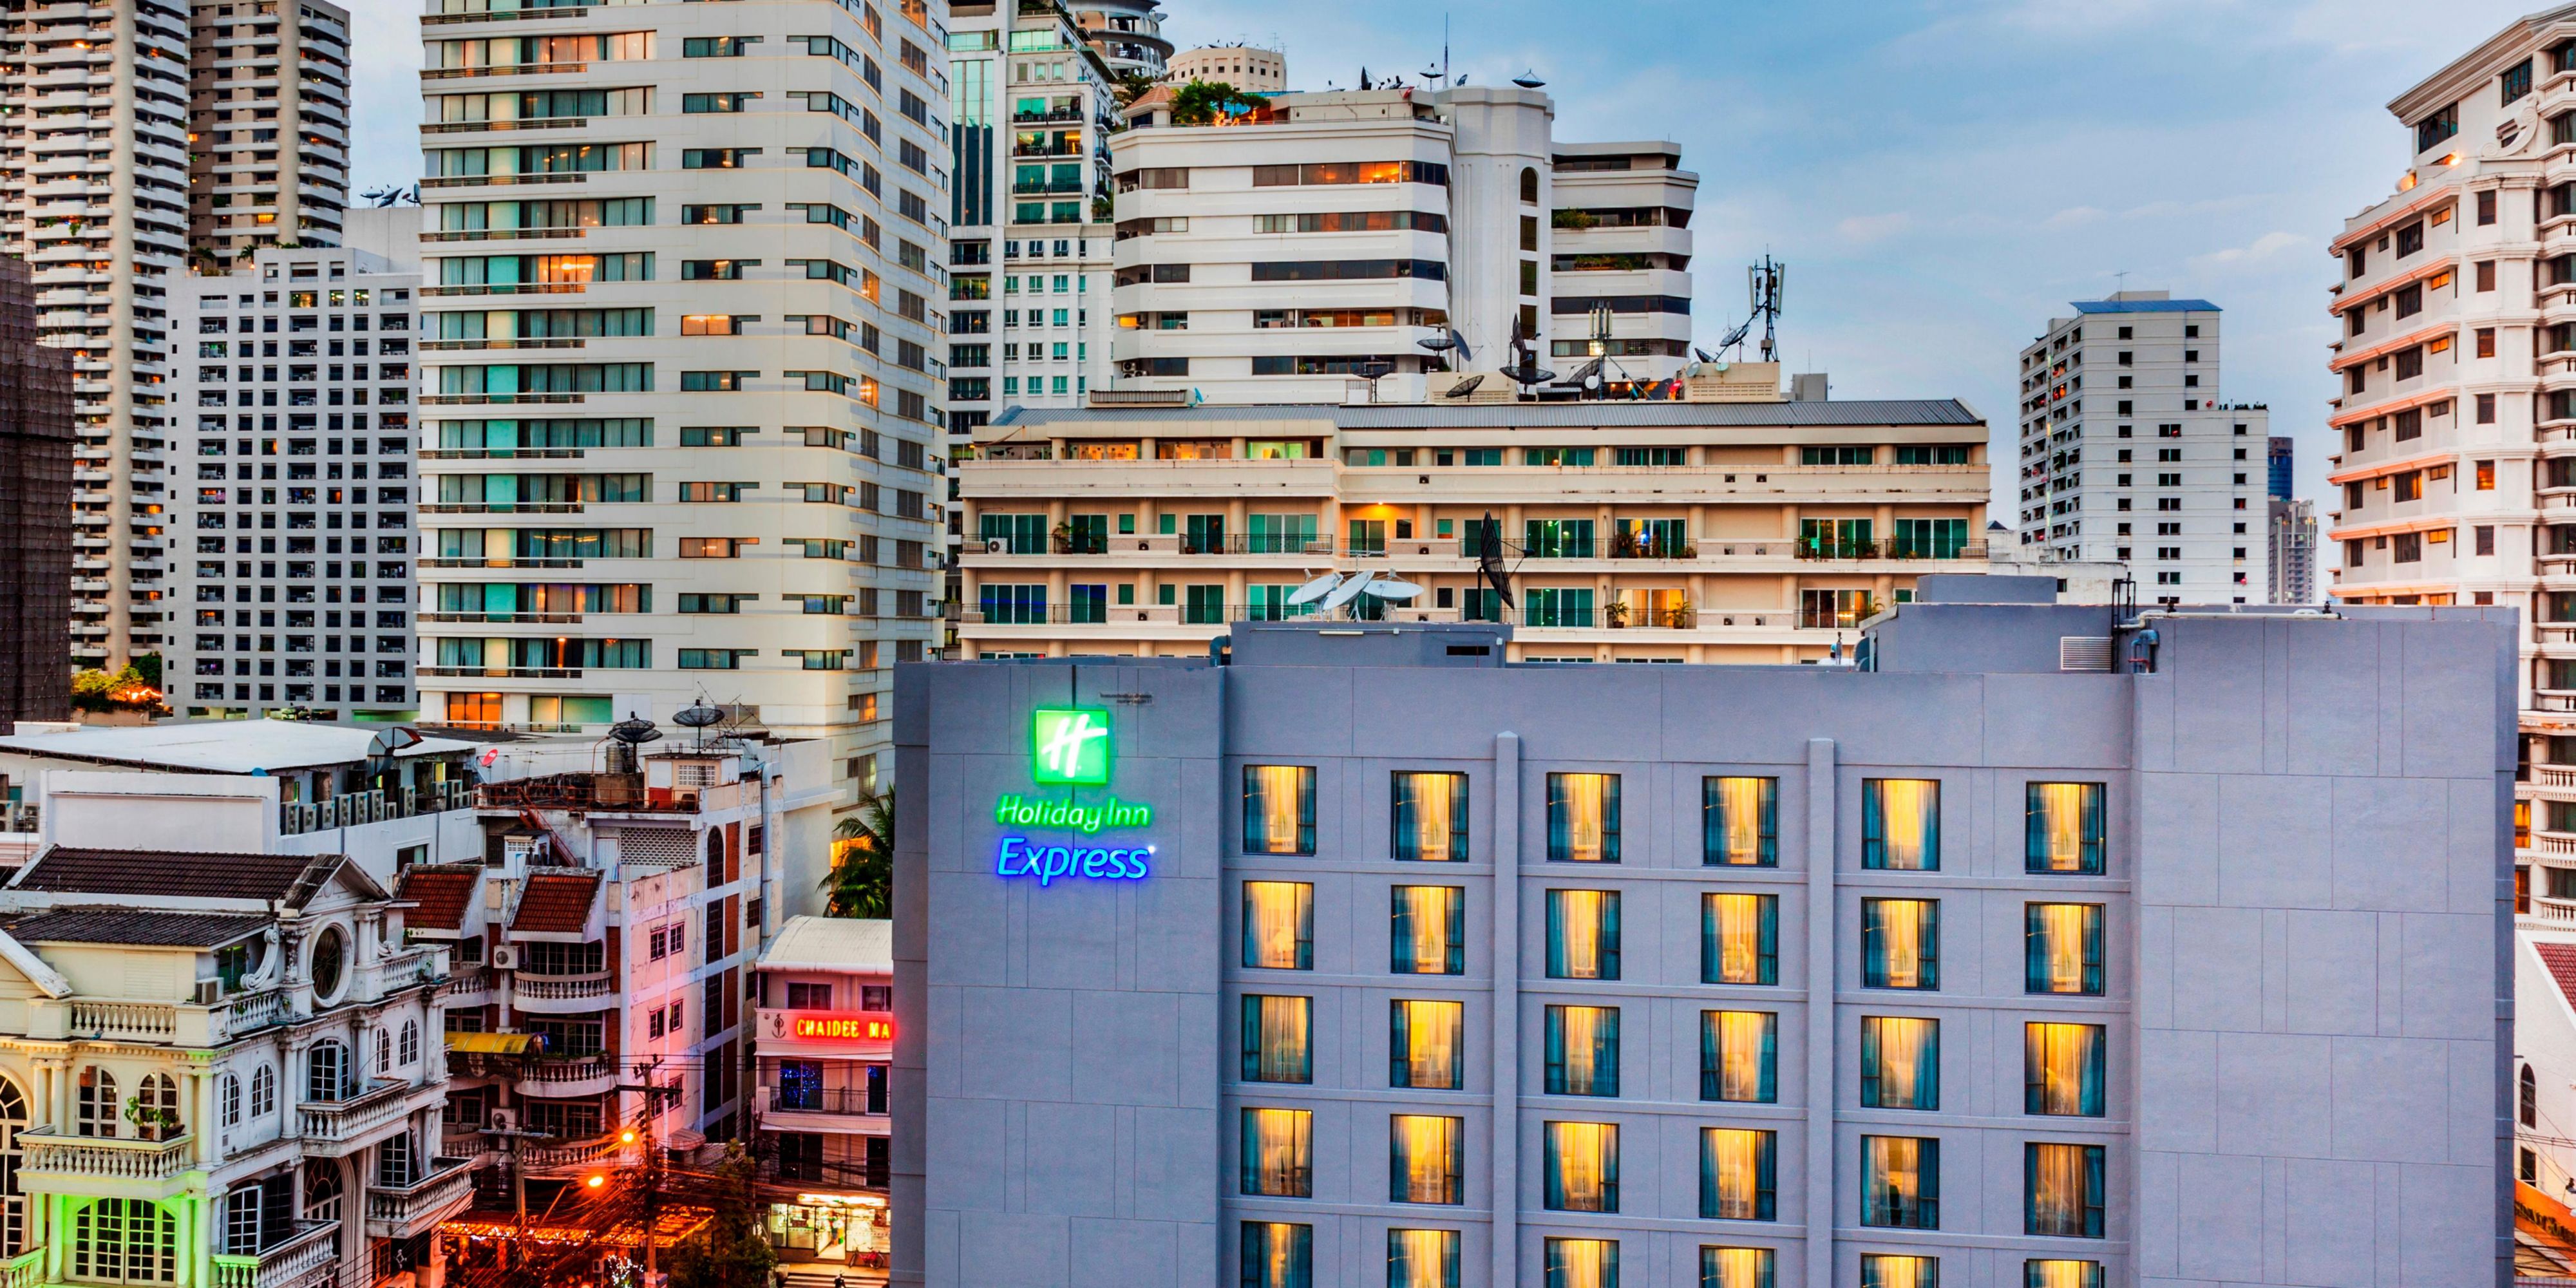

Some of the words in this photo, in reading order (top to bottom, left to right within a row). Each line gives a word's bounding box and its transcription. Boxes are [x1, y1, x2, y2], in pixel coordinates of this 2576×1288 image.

[997, 795, 1103, 832] Holiday
[1106, 797, 1151, 826] Inn
[998, 837, 1150, 886] Express
[797, 1019, 859, 1038] CHAIDEE
[868, 1021, 890, 1039] MA
